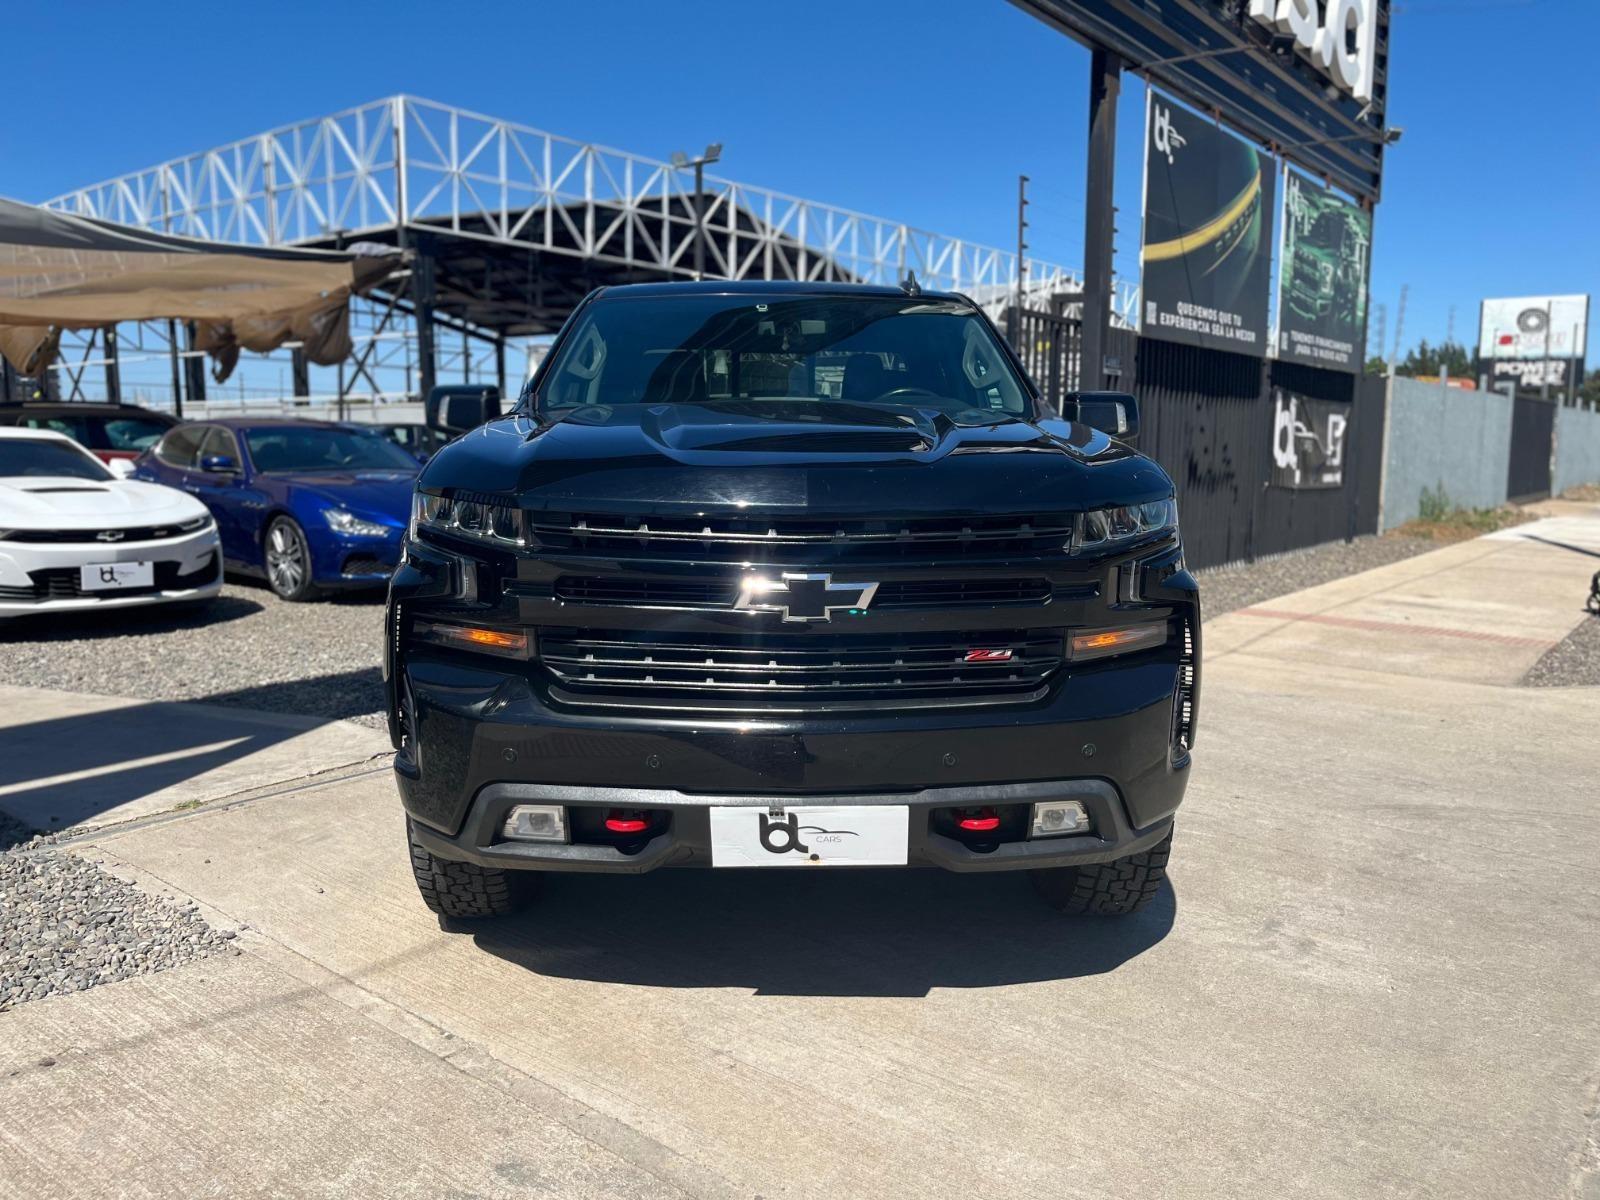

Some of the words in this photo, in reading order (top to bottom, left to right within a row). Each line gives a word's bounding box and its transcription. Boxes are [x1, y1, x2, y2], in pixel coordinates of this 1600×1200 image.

[1218, 310, 1232, 326] QUE
[1233, 314, 1242, 327] TU
[1160, 312, 1210, 334] EXPERIENCIA
[1211, 323, 1224, 337] SEA
[1225, 326, 1234, 339] LA
[1235, 328, 1256, 343] MEJOR
[815, 835, 842, 843] CARS
